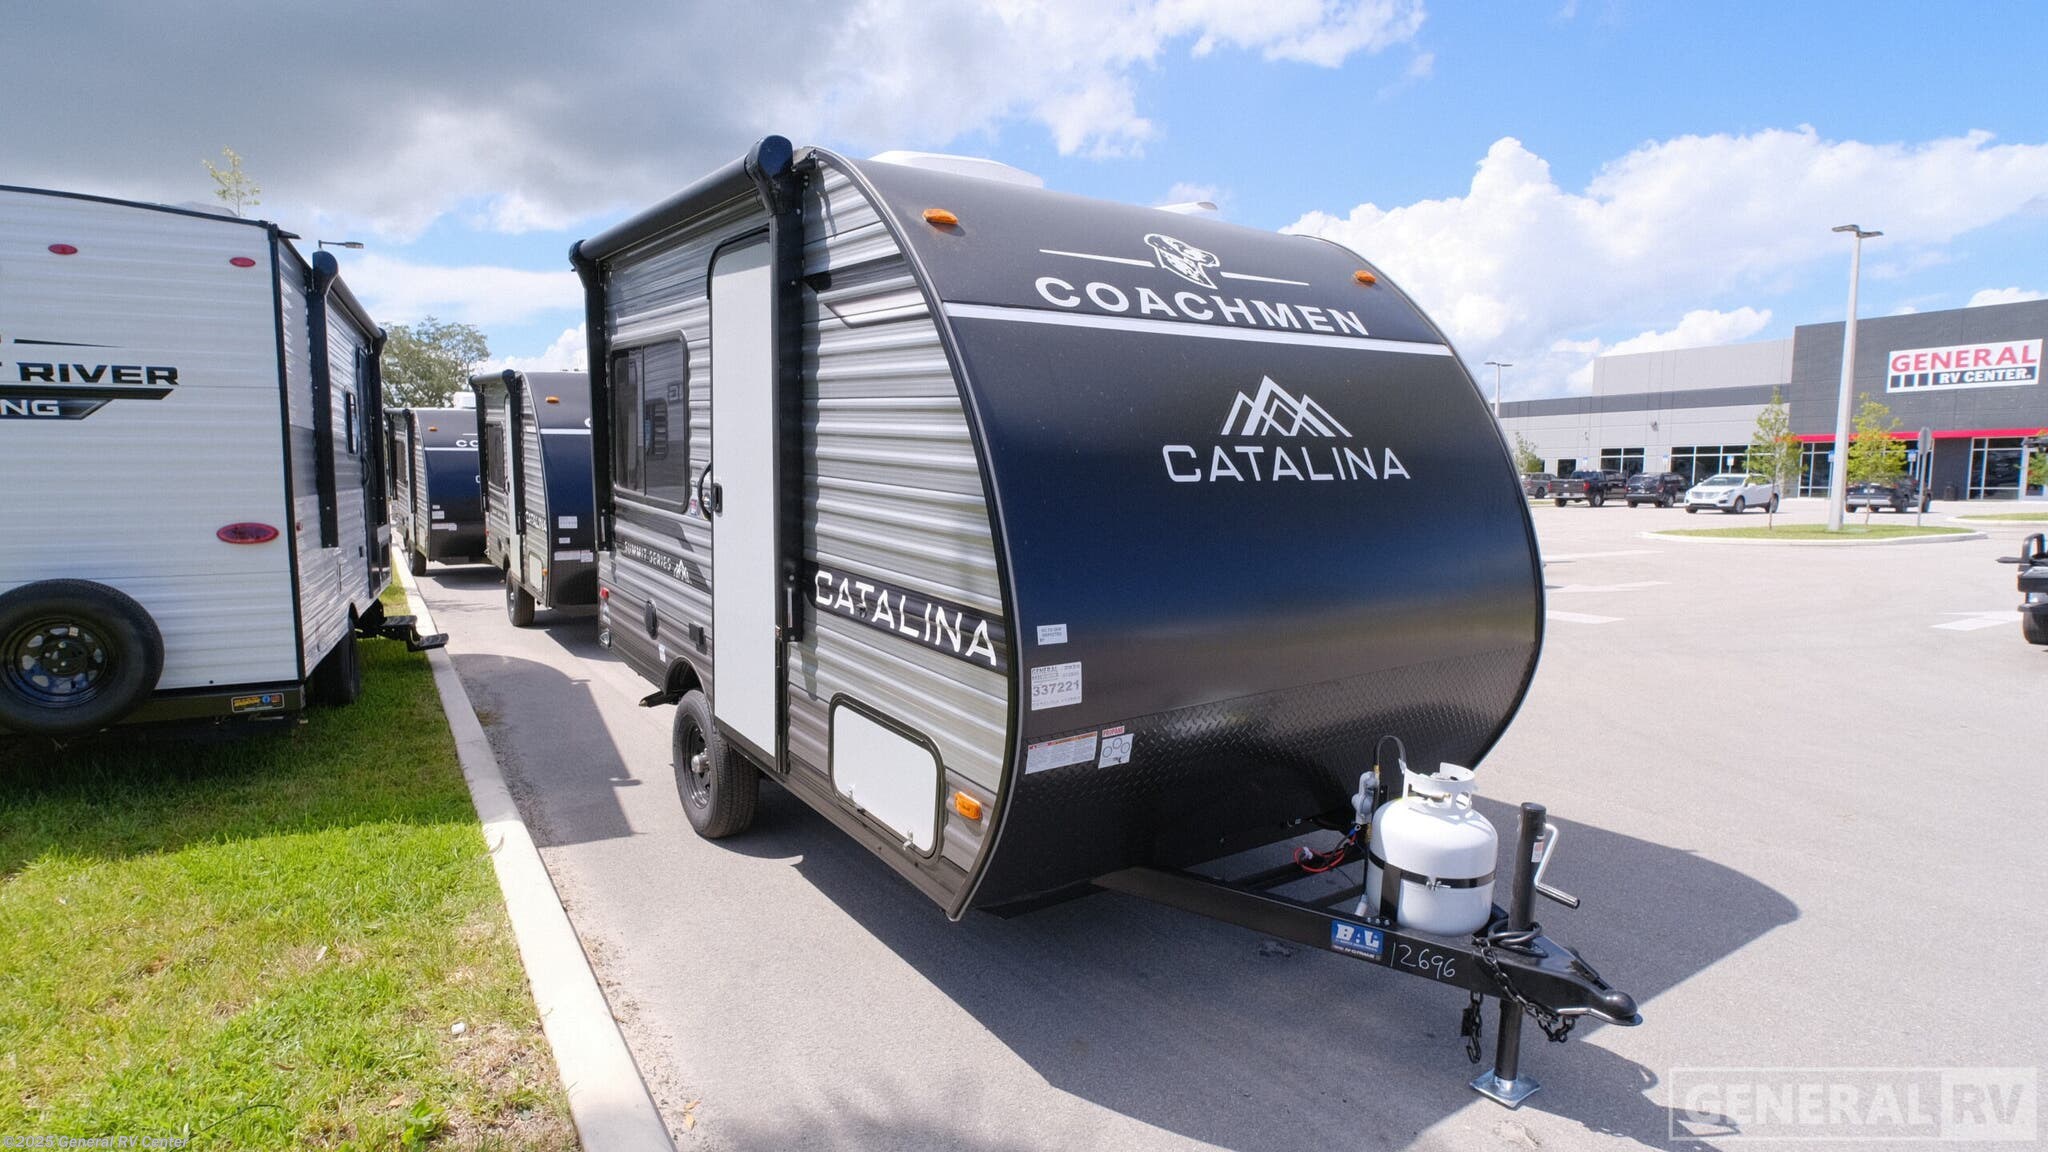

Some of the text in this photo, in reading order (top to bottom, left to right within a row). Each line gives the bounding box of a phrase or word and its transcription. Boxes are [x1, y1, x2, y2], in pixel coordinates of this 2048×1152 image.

[1035, 276, 1369, 336] COACHMEN
[16, 362, 179, 385] RIVER
[1891, 345, 2037, 373] GENERAL
[1939, 372, 1962, 384] RV
[1162, 444, 1411, 483] CATALINA
[624, 541, 672, 571] SUMMIT SERIES
[815, 570, 998, 666] CATALINA
[1033, 680, 1079, 697] 337221
